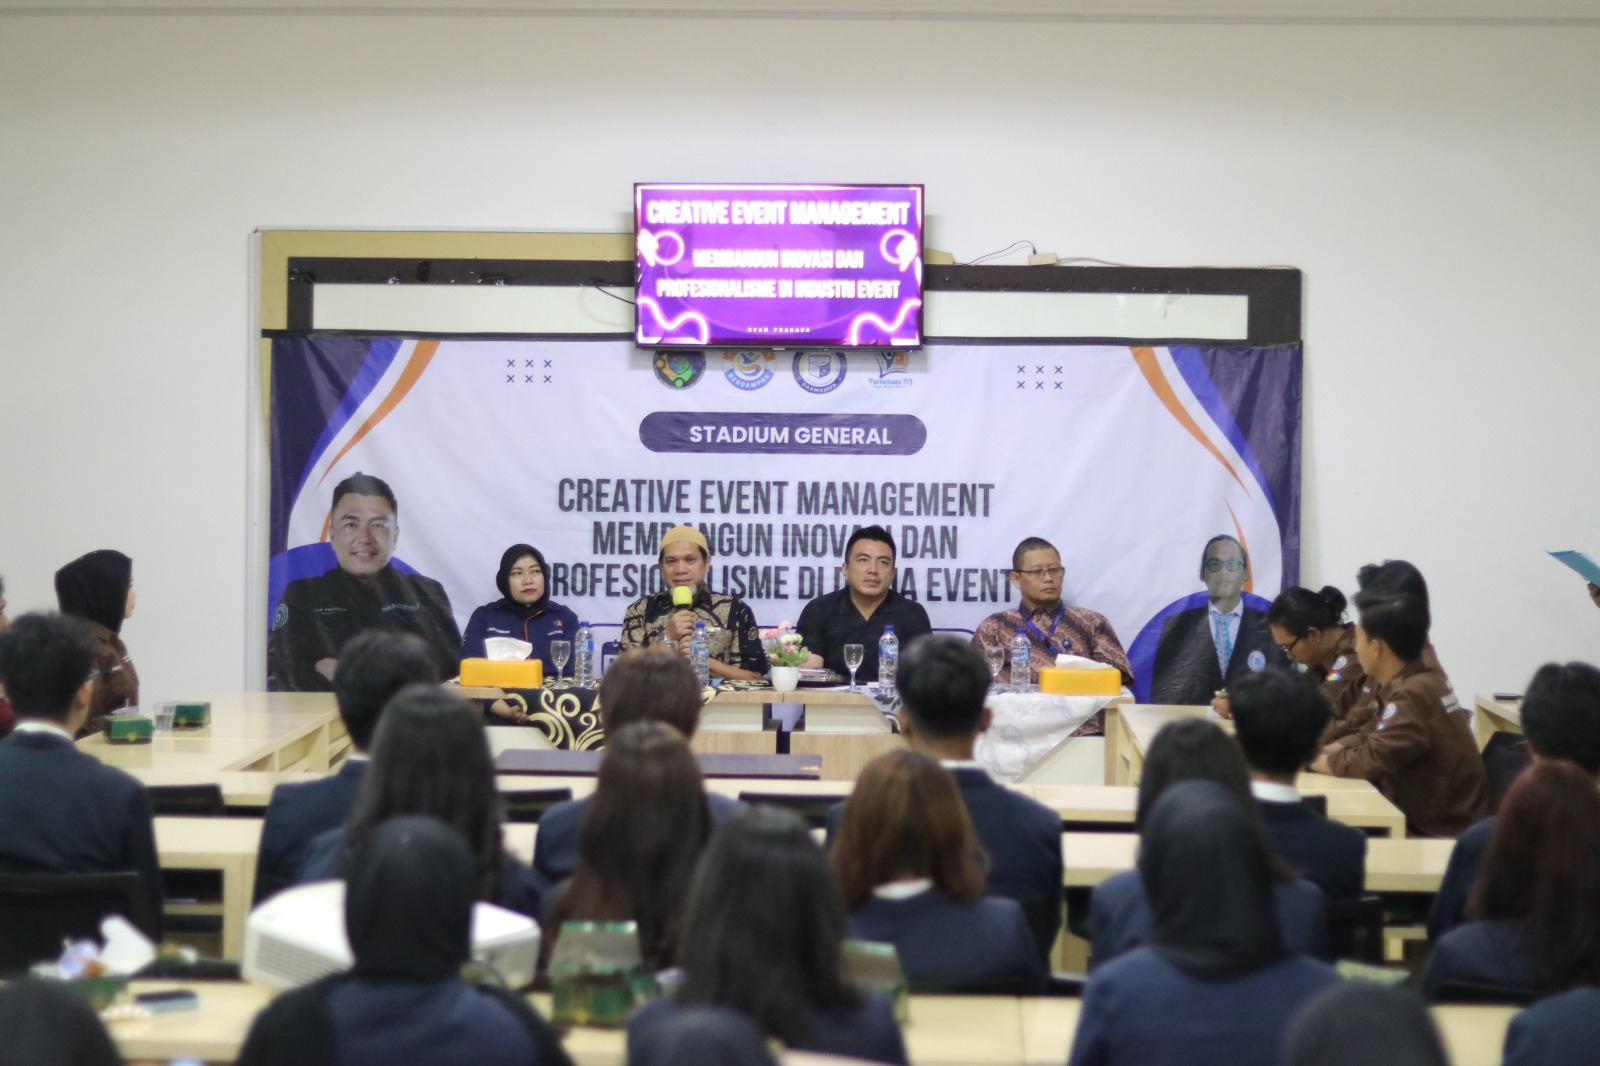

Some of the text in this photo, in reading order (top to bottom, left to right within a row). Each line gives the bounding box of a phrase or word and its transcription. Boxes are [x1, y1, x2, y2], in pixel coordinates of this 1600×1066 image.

[648, 201, 910, 225] CREATIVE EVENT MANAGEMENT
[780, 250, 834, 268] INOVASI
[836, 250, 864, 268] DAN
[657, 279, 900, 299] PROFESIONALISME DI INDUSTRI EVENT
[727, 371, 771, 389] BERDAMPAK
[689, 425, 892, 445] STADIUM GENERAL
[558, 478, 995, 518] CREATIVE EVENT MANAGEMENT
[592, 521, 773, 558] MEMNGUN
[901, 524, 958, 560] DAN
[798, 566, 824, 600] DI
[926, 567, 1013, 603] EVENT
